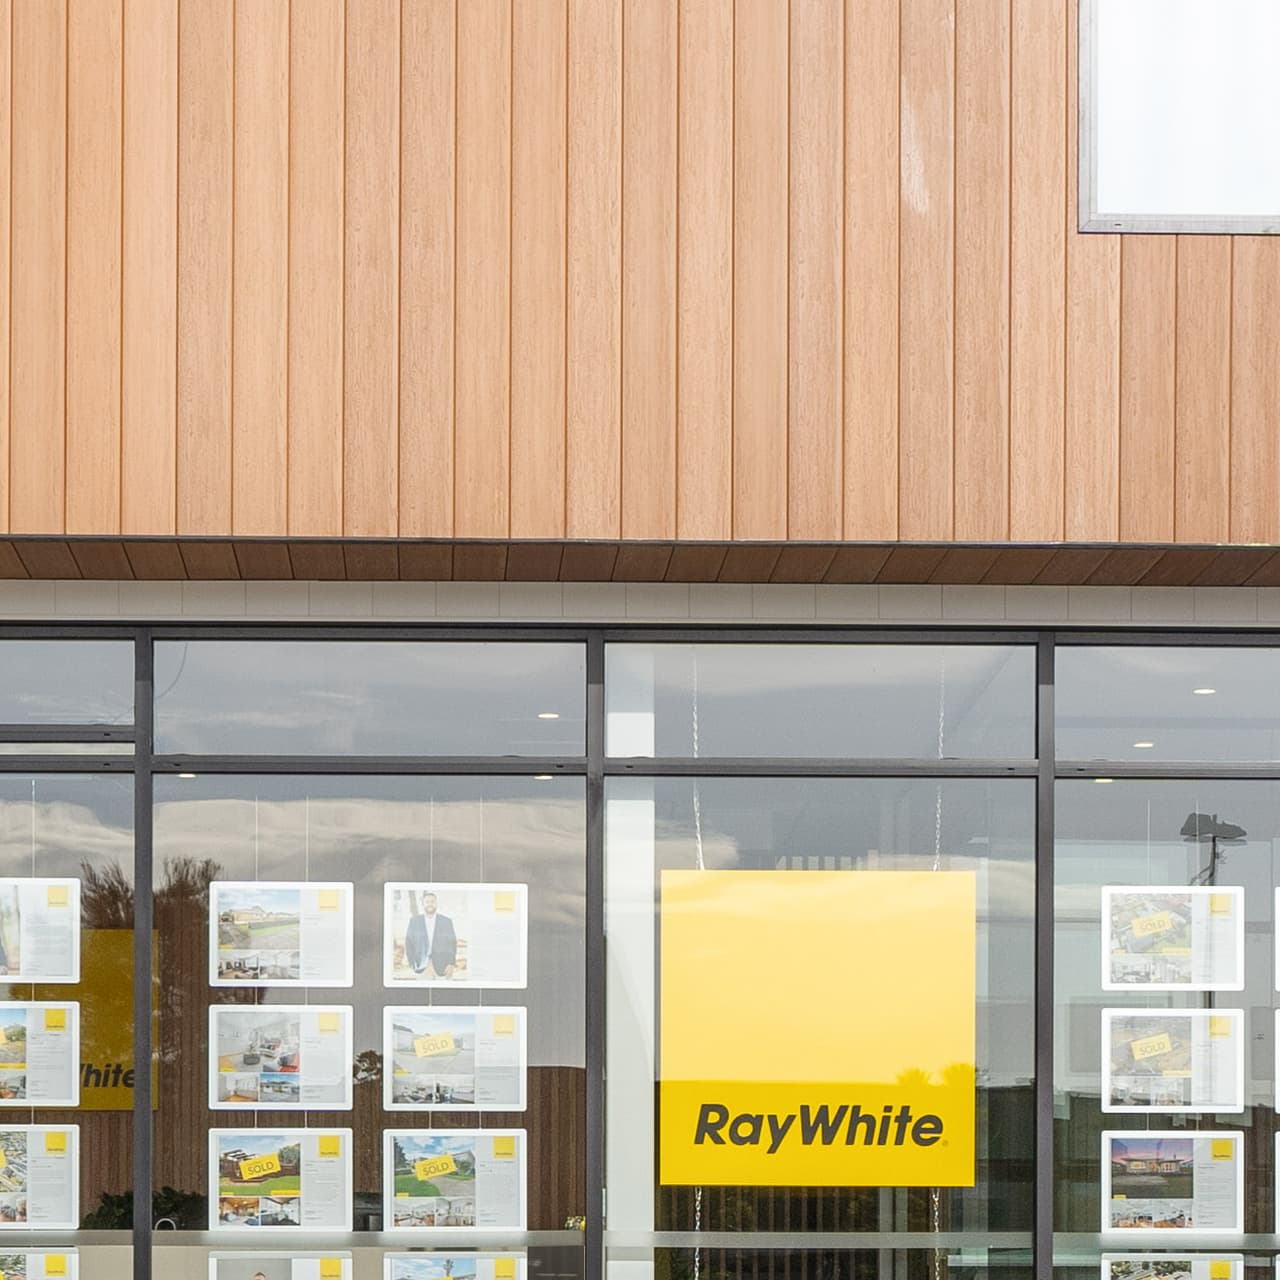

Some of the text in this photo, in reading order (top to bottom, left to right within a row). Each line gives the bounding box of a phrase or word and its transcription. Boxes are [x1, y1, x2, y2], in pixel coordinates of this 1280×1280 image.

[80, 1063, 135, 1088] hite
[694, 1103, 945, 1154] RayWhite
[248, 1161, 274, 1175] SOLD
[423, 1162, 449, 1176] SOLD
